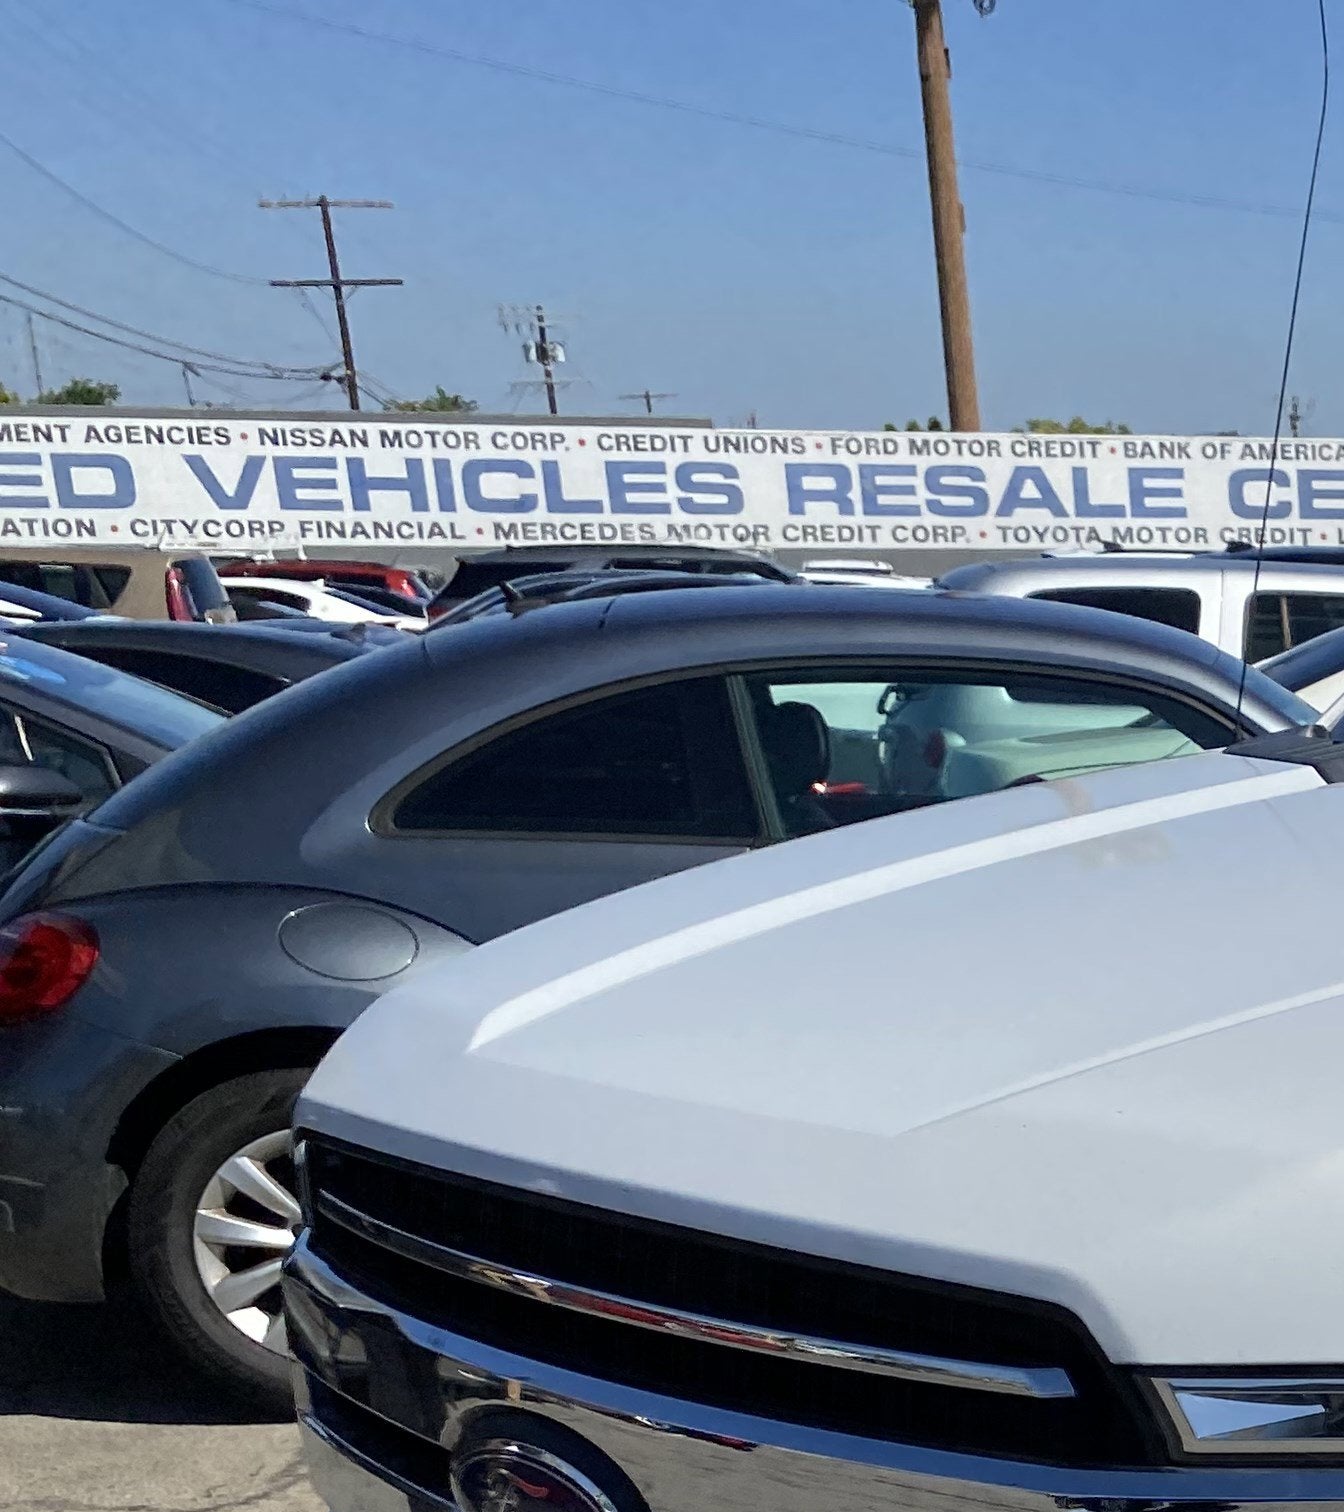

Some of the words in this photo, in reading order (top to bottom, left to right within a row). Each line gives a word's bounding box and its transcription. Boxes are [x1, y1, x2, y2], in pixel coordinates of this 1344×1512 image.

[84, 424, 232, 446] AGENCIES
[258, 427, 369, 448] NISSAN
[380, 429, 481, 450] MOTOR
[491, 431, 571, 452] CORP.
[597, 433, 693, 453] CREDIT
[703, 435, 806, 455] UNIONS
[831, 436, 899, 456] FORD
[908, 438, 1001, 457] MOTOR
[1011, 439, 1101, 459] CREDIT
[1124, 441, 1192, 460] BANK
[1201, 442, 1233, 460] OF
[181, 453, 745, 515] VEHICLES
[784, 462, 1188, 519] RESALE
[129, 518, 286, 540] CITYCORP
[298, 520, 467, 541] FINANCIAL
[492, 521, 658, 542] MERCEDES
[665, 522, 770, 543] MOTOR
[781, 524, 882, 544] CREDIT
[891, 525, 972, 545] CORP.
[995, 525, 1103, 545] TOYOTA
[1112, 526, 1209, 545] MOTOR
[1219, 527, 1313, 546] CREDIT
